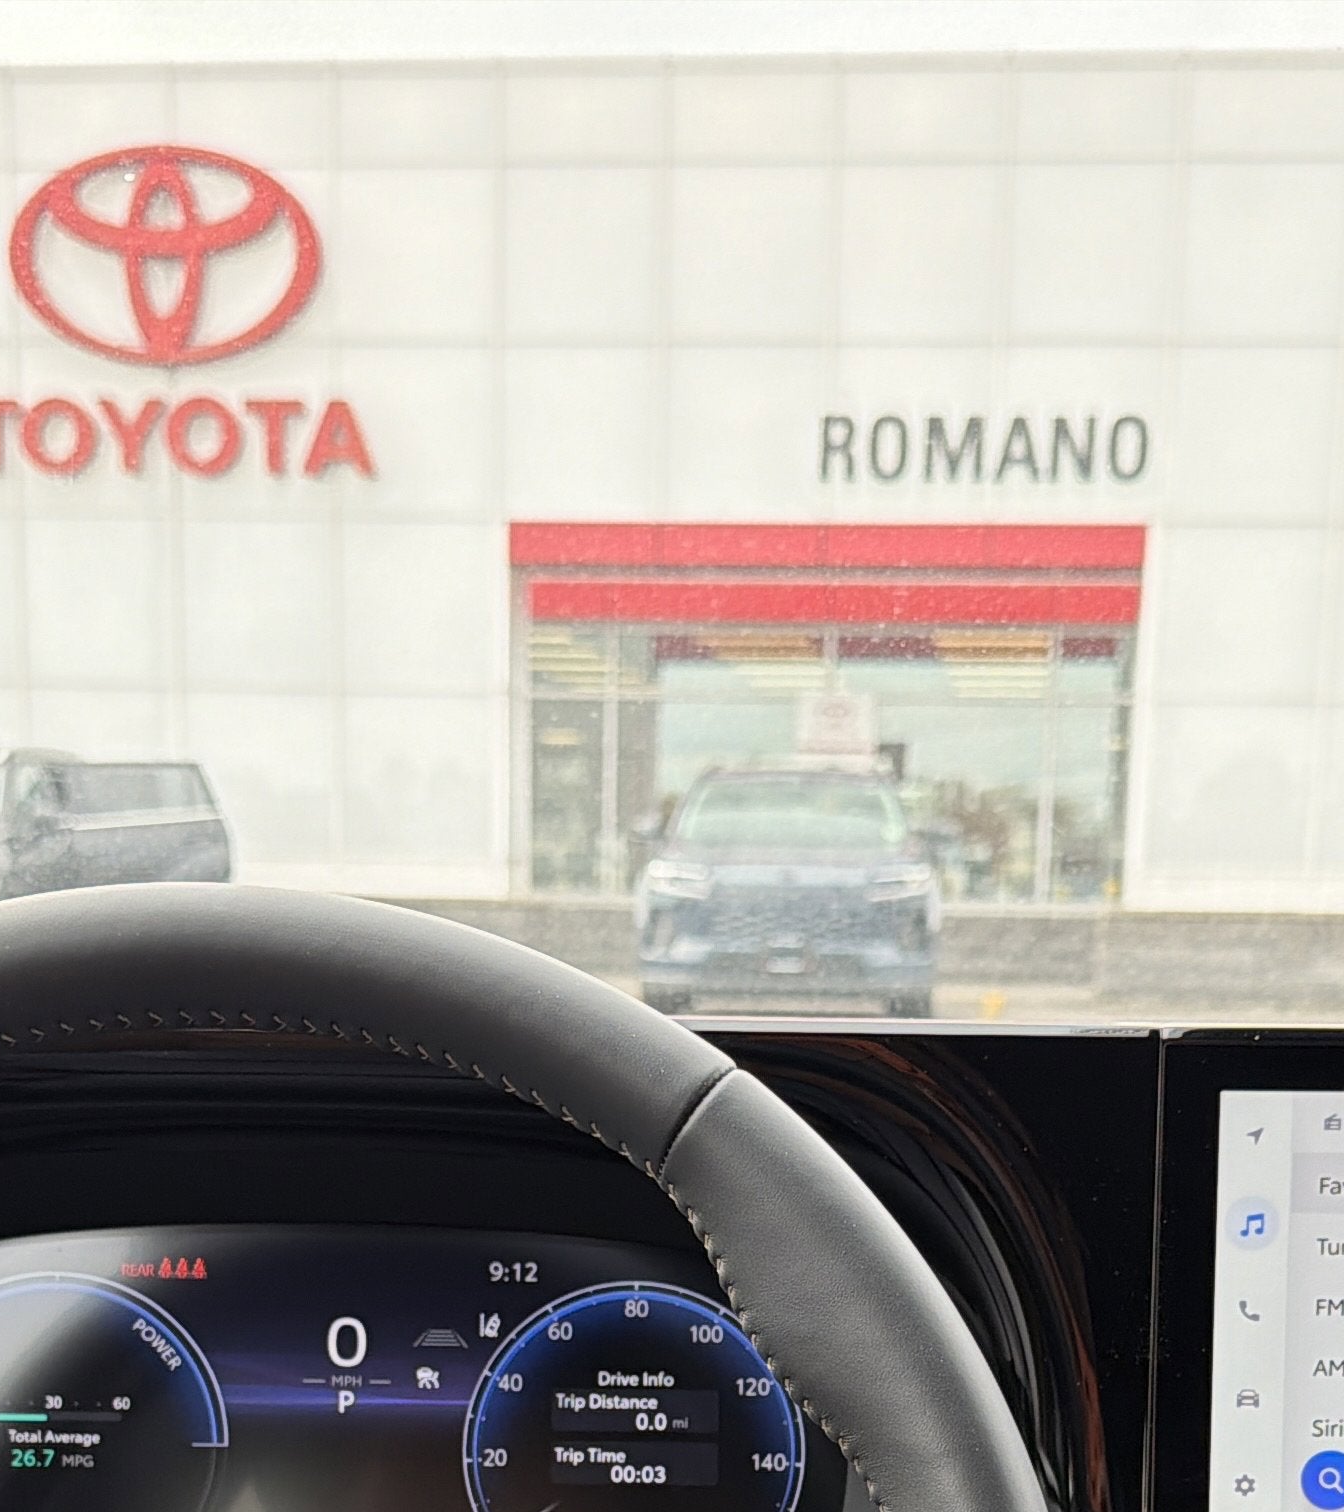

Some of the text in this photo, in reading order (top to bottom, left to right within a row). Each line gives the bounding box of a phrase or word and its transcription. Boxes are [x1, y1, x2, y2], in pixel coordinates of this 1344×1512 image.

[820, 415, 1149, 482] ROMANO
[121, 1264, 154, 1277] REAR
[488, 1261, 538, 1283] 9:12
[624, 1300, 649, 1318] 80
[547, 1323, 573, 1341] 60
[690, 1325, 724, 1344] 100
[131, 1318, 182, 1371] POWER
[327, 1316, 367, 1368] 0
[331, 1375, 363, 1387] MPH
[498, 1373, 523, 1392] 40
[597, 1371, 675, 1388] Drive Info
[736, 1377, 771, 1397] 120
[45, 1395, 63, 1410] 30
[113, 1396, 131, 1411] 60
[338, 1391, 355, 1414] P
[556, 1393, 659, 1410] Trip Distance
[635, 1413, 689, 1432] 0.0 mi
[8, 1429, 101, 1447] Total Average
[10, 1449, 95, 1468] 26.7 MPG
[482, 1449, 507, 1467] 20
[555, 1447, 627, 1463] Trip Time
[751, 1453, 786, 1471] 140
[610, 1464, 667, 1484] 00:03
